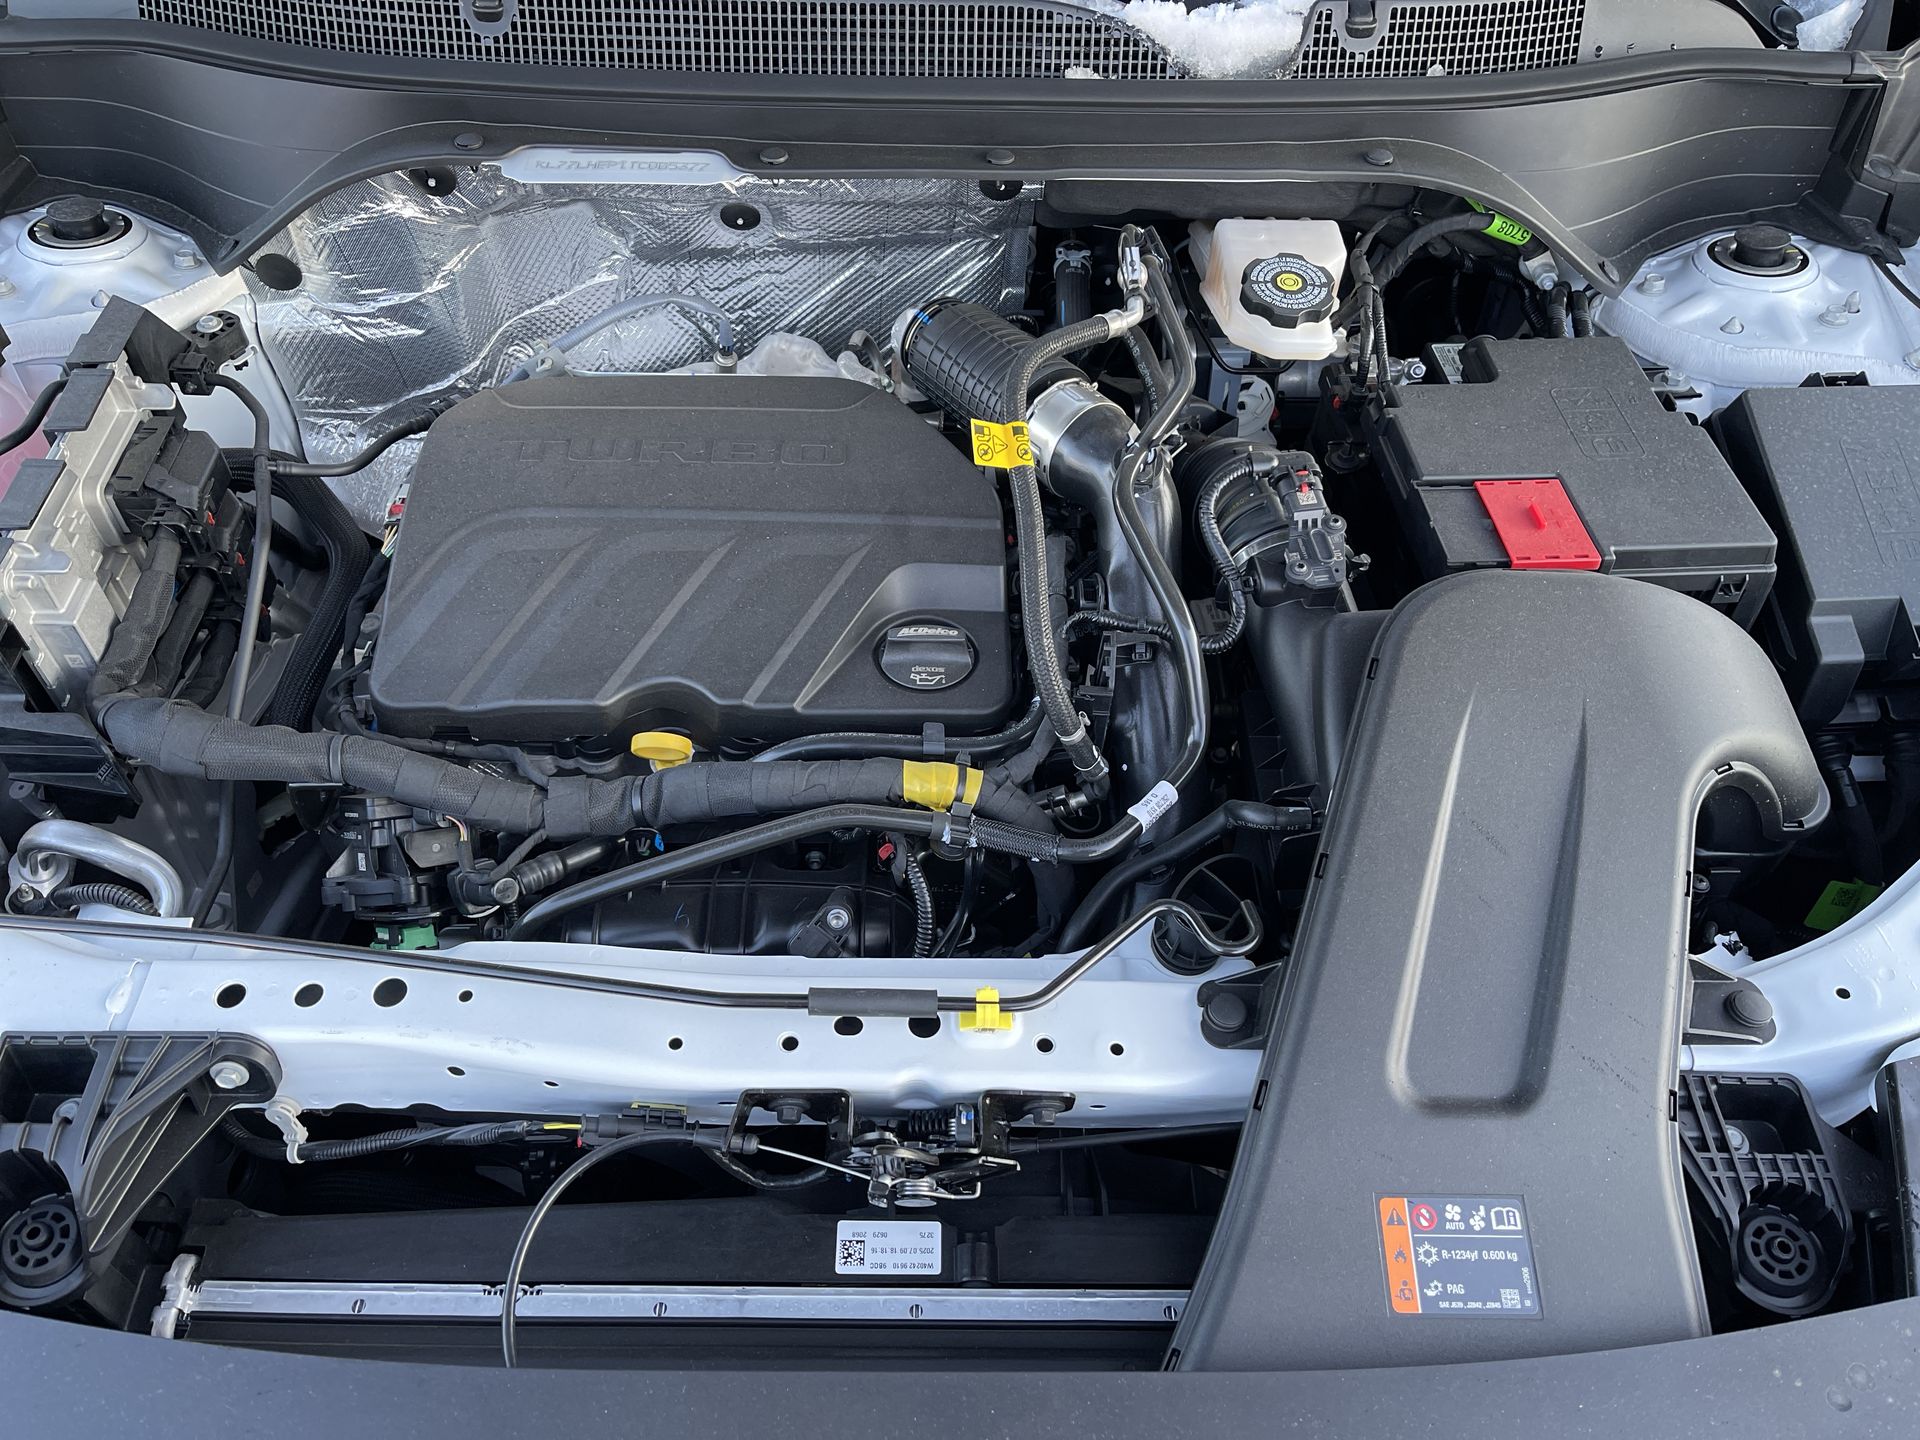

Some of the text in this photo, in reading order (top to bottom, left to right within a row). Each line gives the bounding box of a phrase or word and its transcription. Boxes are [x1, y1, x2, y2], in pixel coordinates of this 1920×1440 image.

[1496, 220, 1529, 242] 5708
[499, 439, 847, 466] TURBO
[897, 627, 959, 637] ACDelco
[911, 665, 945, 673] dexos
[1445, 1222, 1465, 1230] AUTO
[919, 1231, 935, 1239] 3275
[1441, 1250, 1518, 1262] R-1234yf 0.600 kg
[1446, 1283, 1465, 1294] PAG
